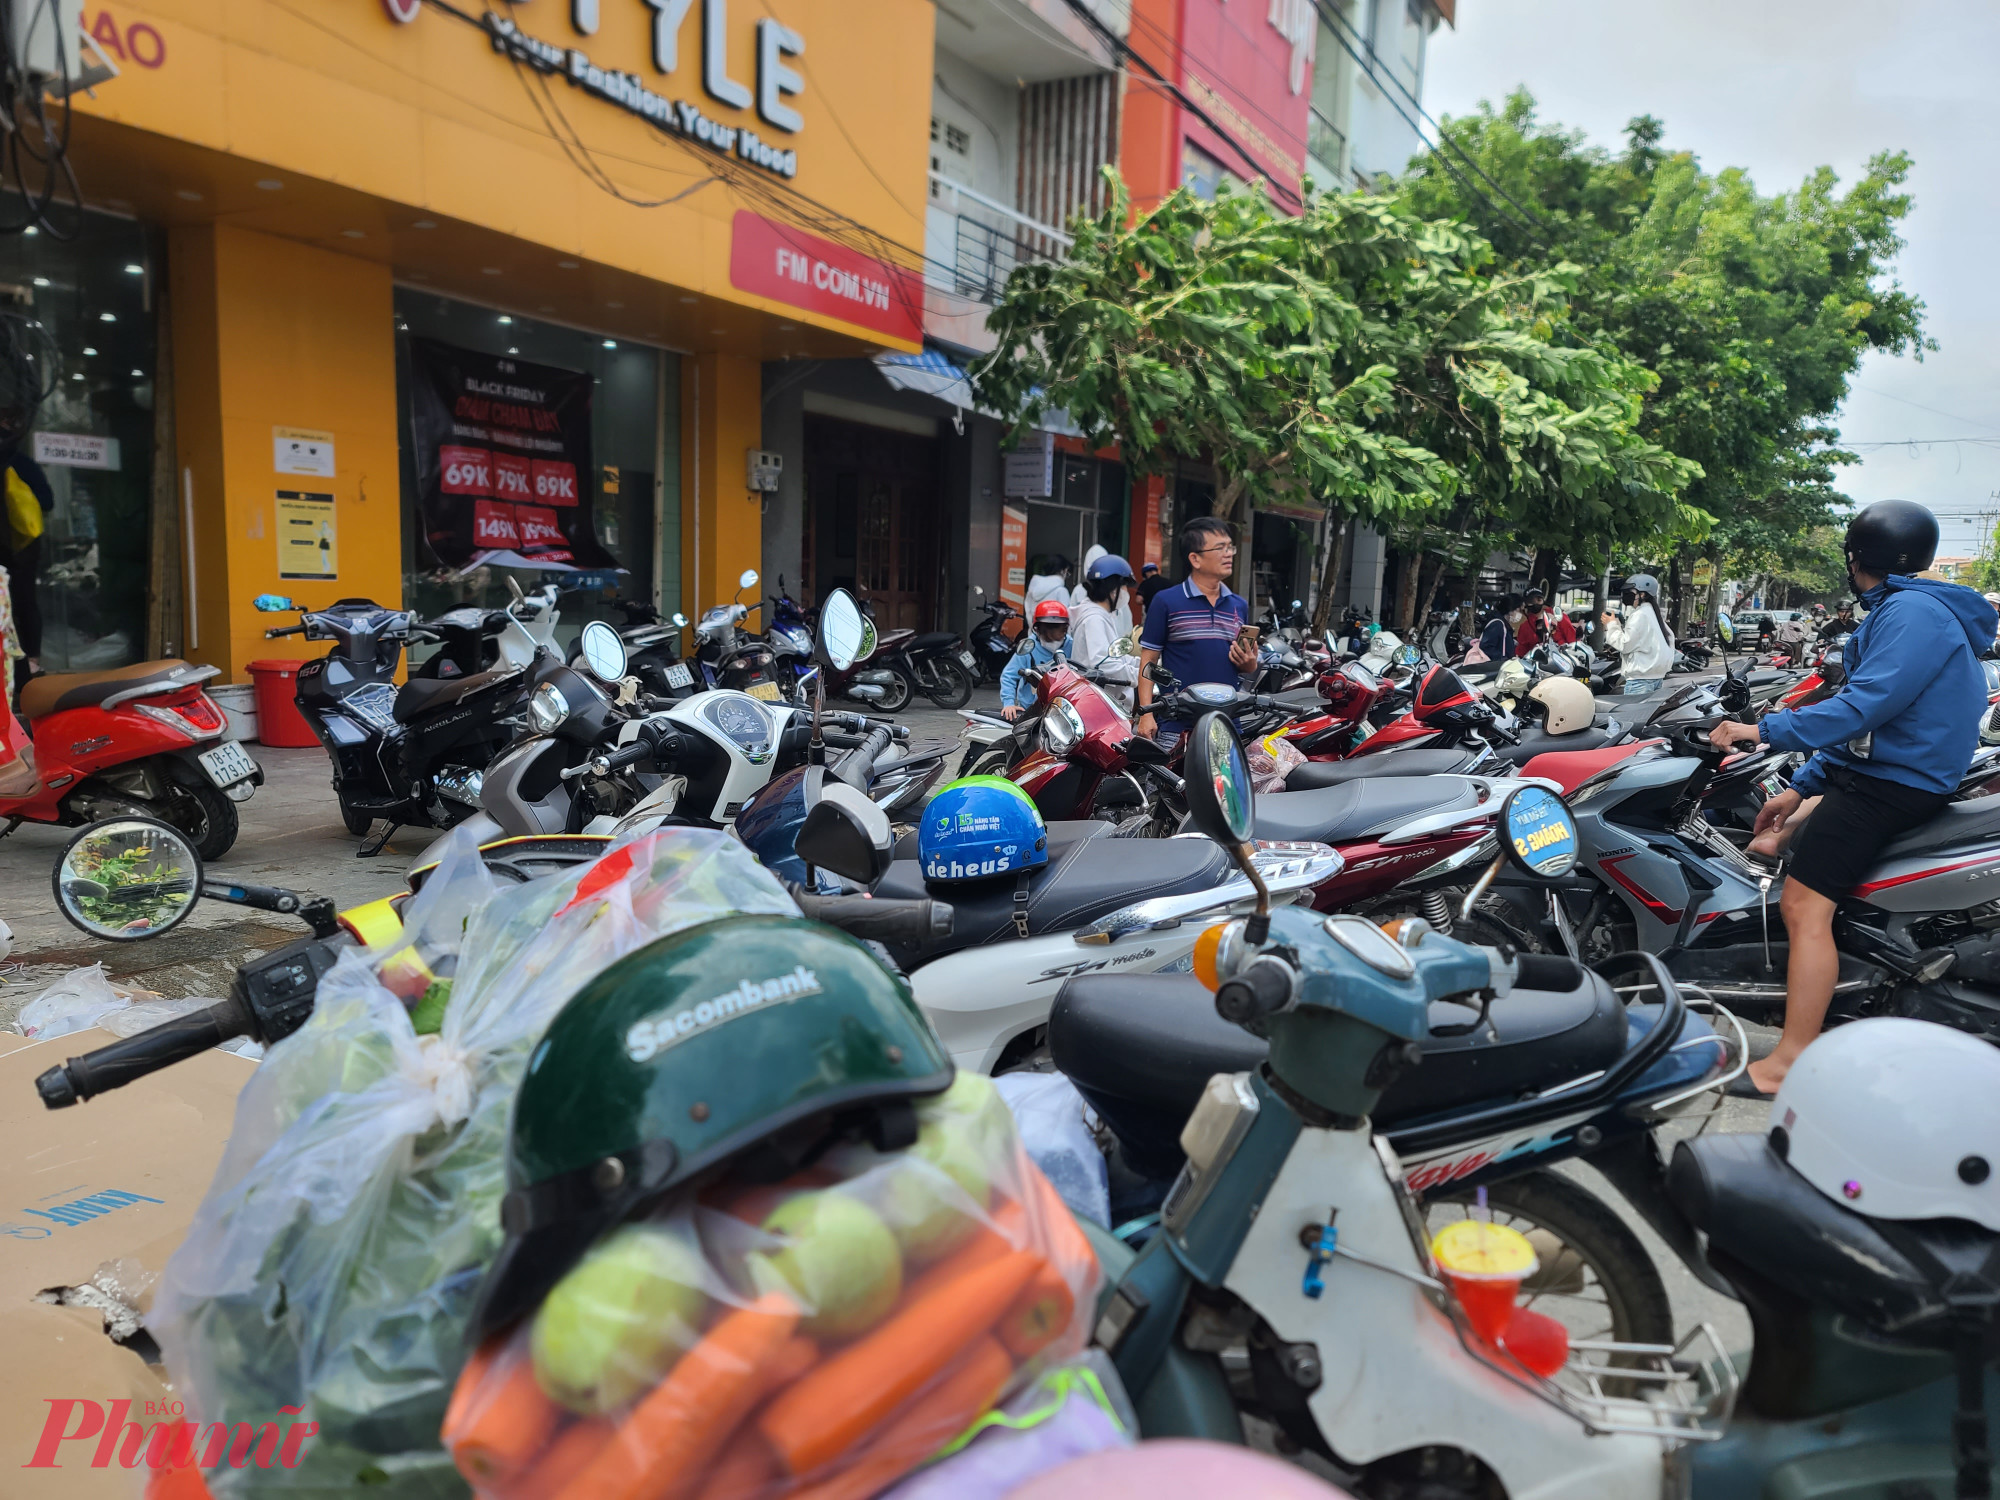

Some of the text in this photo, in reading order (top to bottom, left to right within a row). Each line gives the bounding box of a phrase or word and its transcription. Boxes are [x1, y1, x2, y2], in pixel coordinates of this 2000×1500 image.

[80, 10, 166, 69] AO
[738, 130, 797, 179] Mood
[465, 378, 546, 402] BLACK FRIDAY
[445, 463, 490, 487] 69K
[497, 469, 530, 493] 79K
[536, 475, 575, 498] 89K
[478, 518, 519, 539] 149K
[299, 664, 321, 679] 160
[214, 757, 255, 784] 179.12
[1404, 848, 1437, 861] mode
[1597, 846, 1635, 859] HONDA
[1112, 948, 1156, 966] mode
[626, 965, 820, 1063] Sacombank
